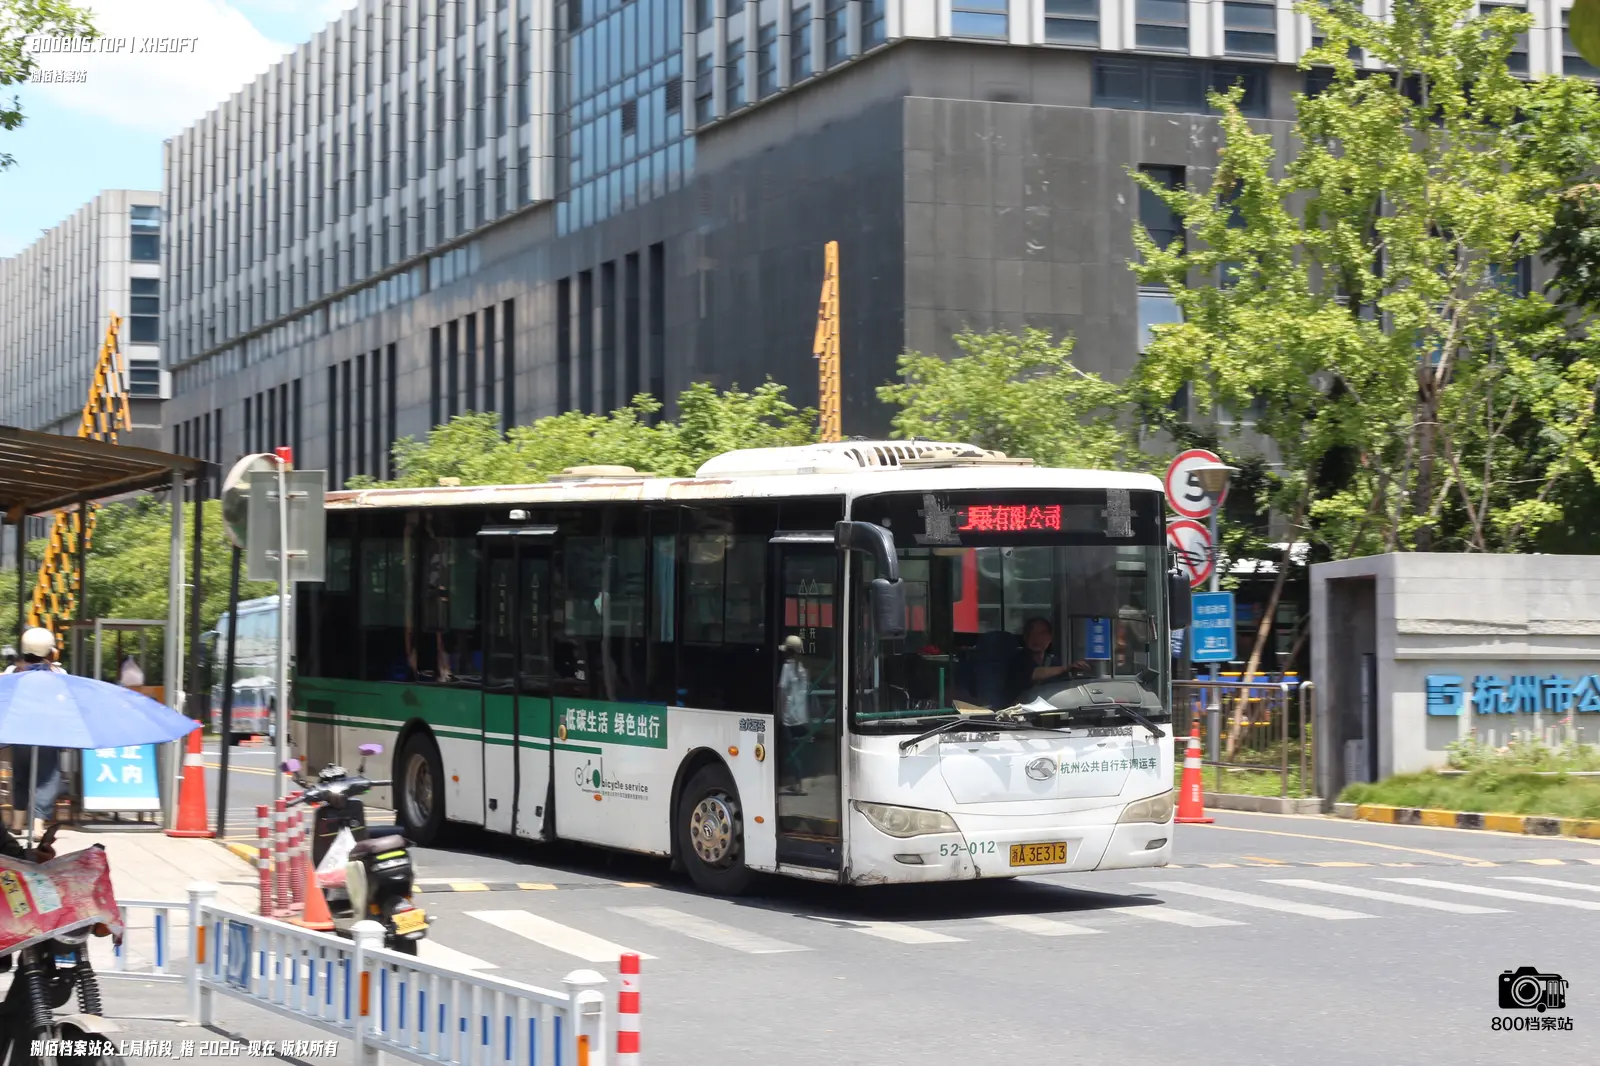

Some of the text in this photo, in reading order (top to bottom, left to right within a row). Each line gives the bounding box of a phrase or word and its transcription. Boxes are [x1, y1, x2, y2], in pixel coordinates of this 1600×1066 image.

[1471, 674, 1600, 714] 杭州市公
[565, 707, 660, 739] 低碳生活 绿色出行
[96, 763, 143, 784] 入内
[1060, 757, 1157, 775] 杭州公共自行车调运车
[601, 779, 624, 791] bicycle
[624, 782, 649, 793] service
[940, 840, 996, 857] 52-012
